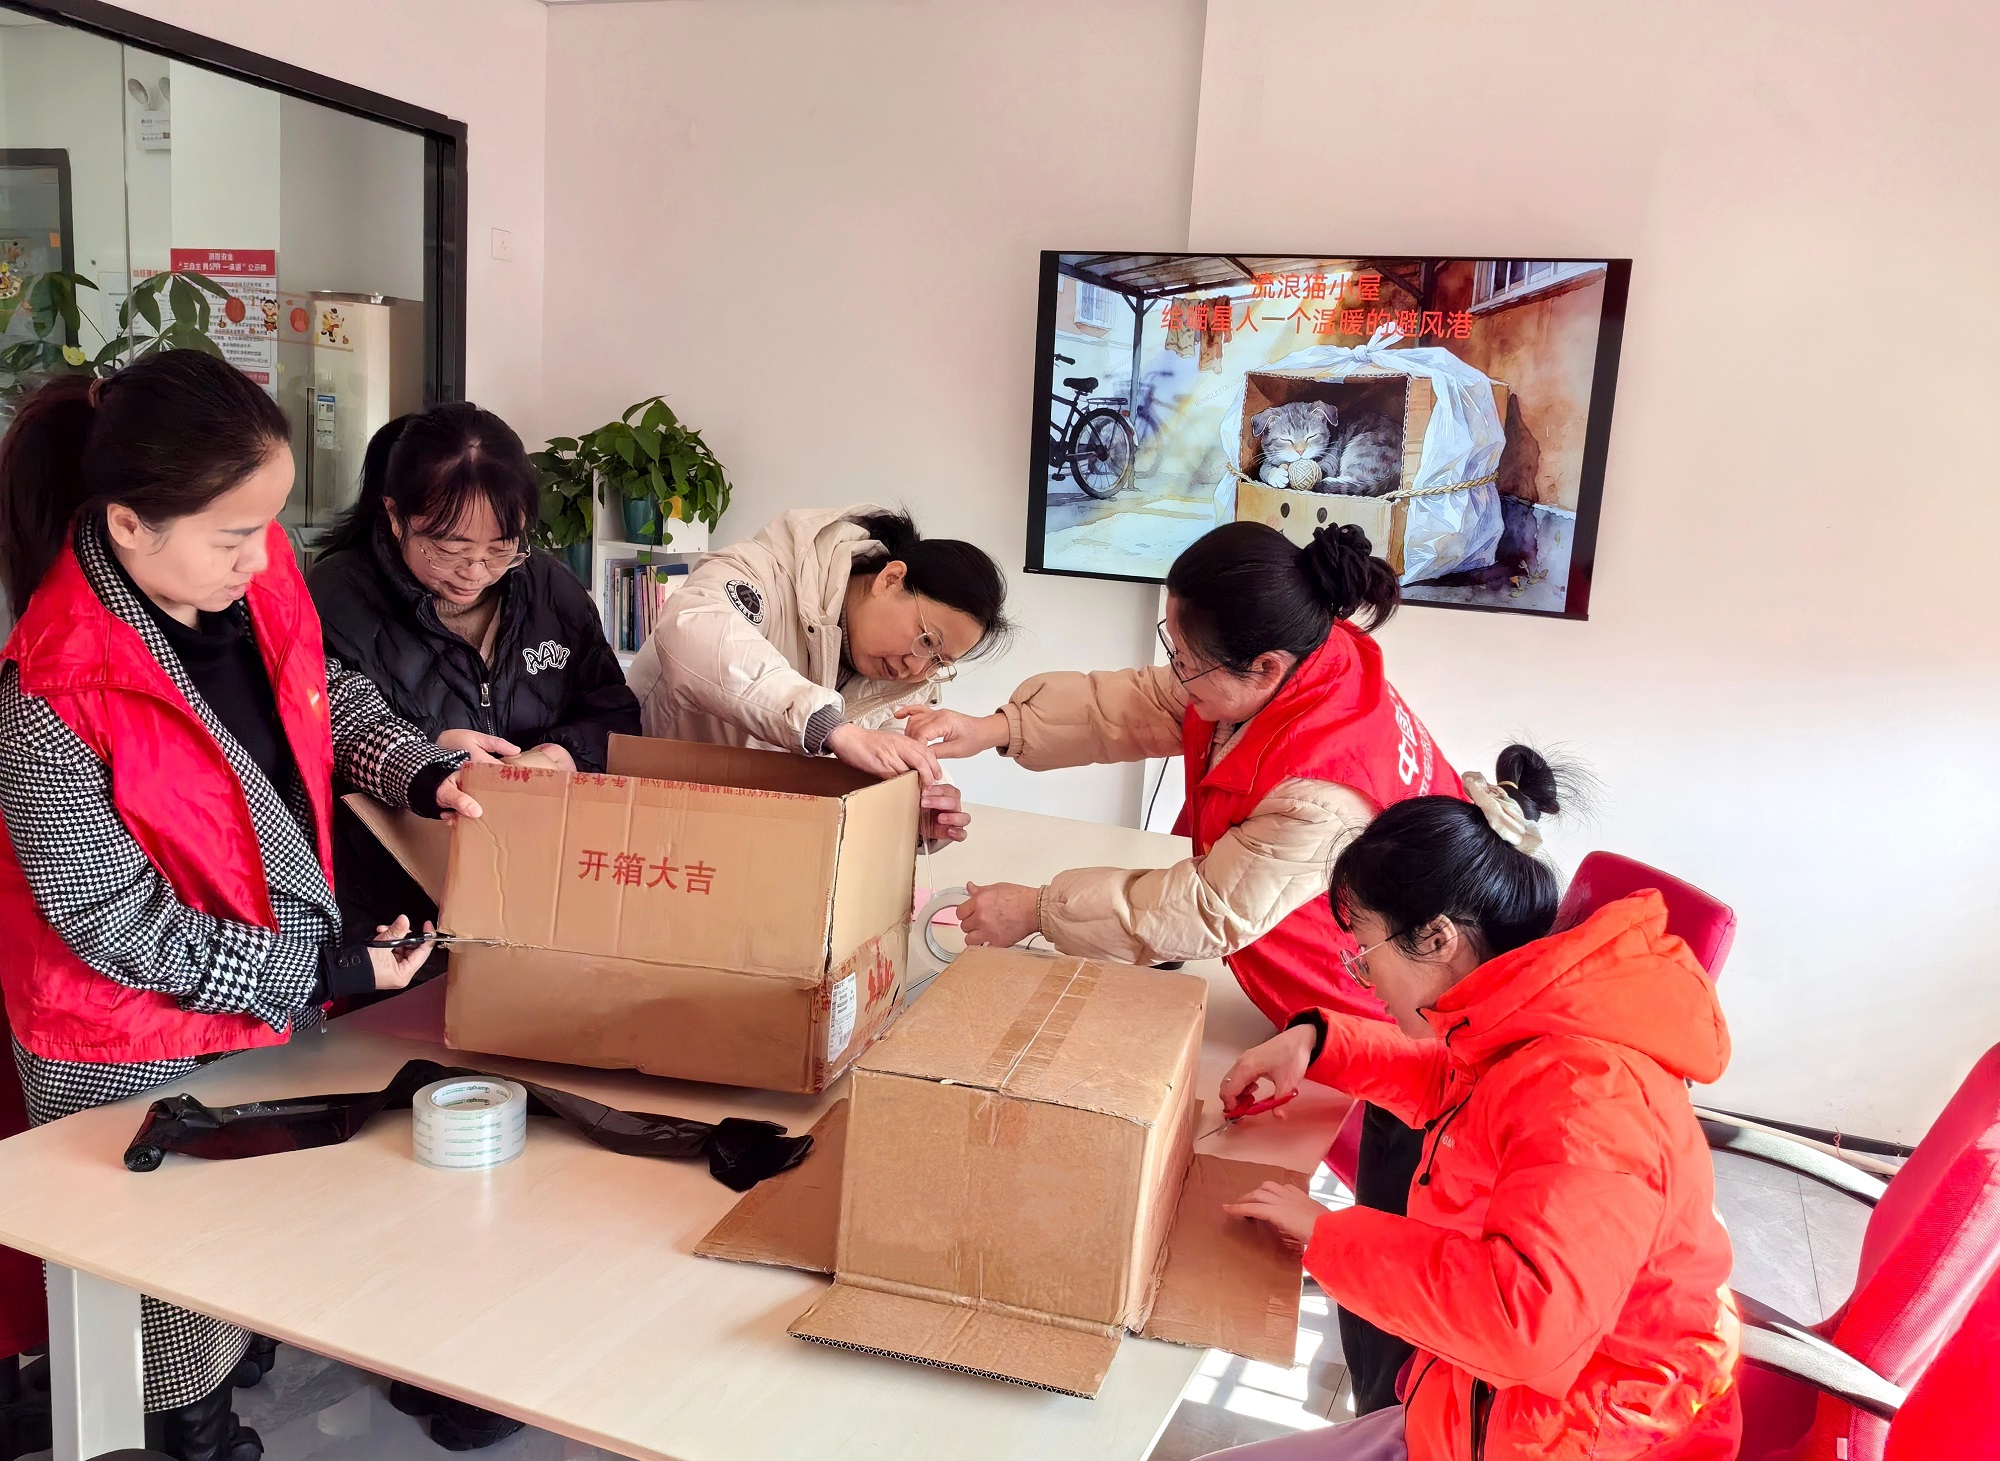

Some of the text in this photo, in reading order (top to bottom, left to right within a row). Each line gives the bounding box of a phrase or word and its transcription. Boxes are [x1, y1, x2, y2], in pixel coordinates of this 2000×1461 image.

[1251, 271, 1381, 302] 流浪猫小屋
[1160, 305, 1474, 340] 给喵星人一个温暖的避风港
[578, 849, 717, 895] 开箱大吉
